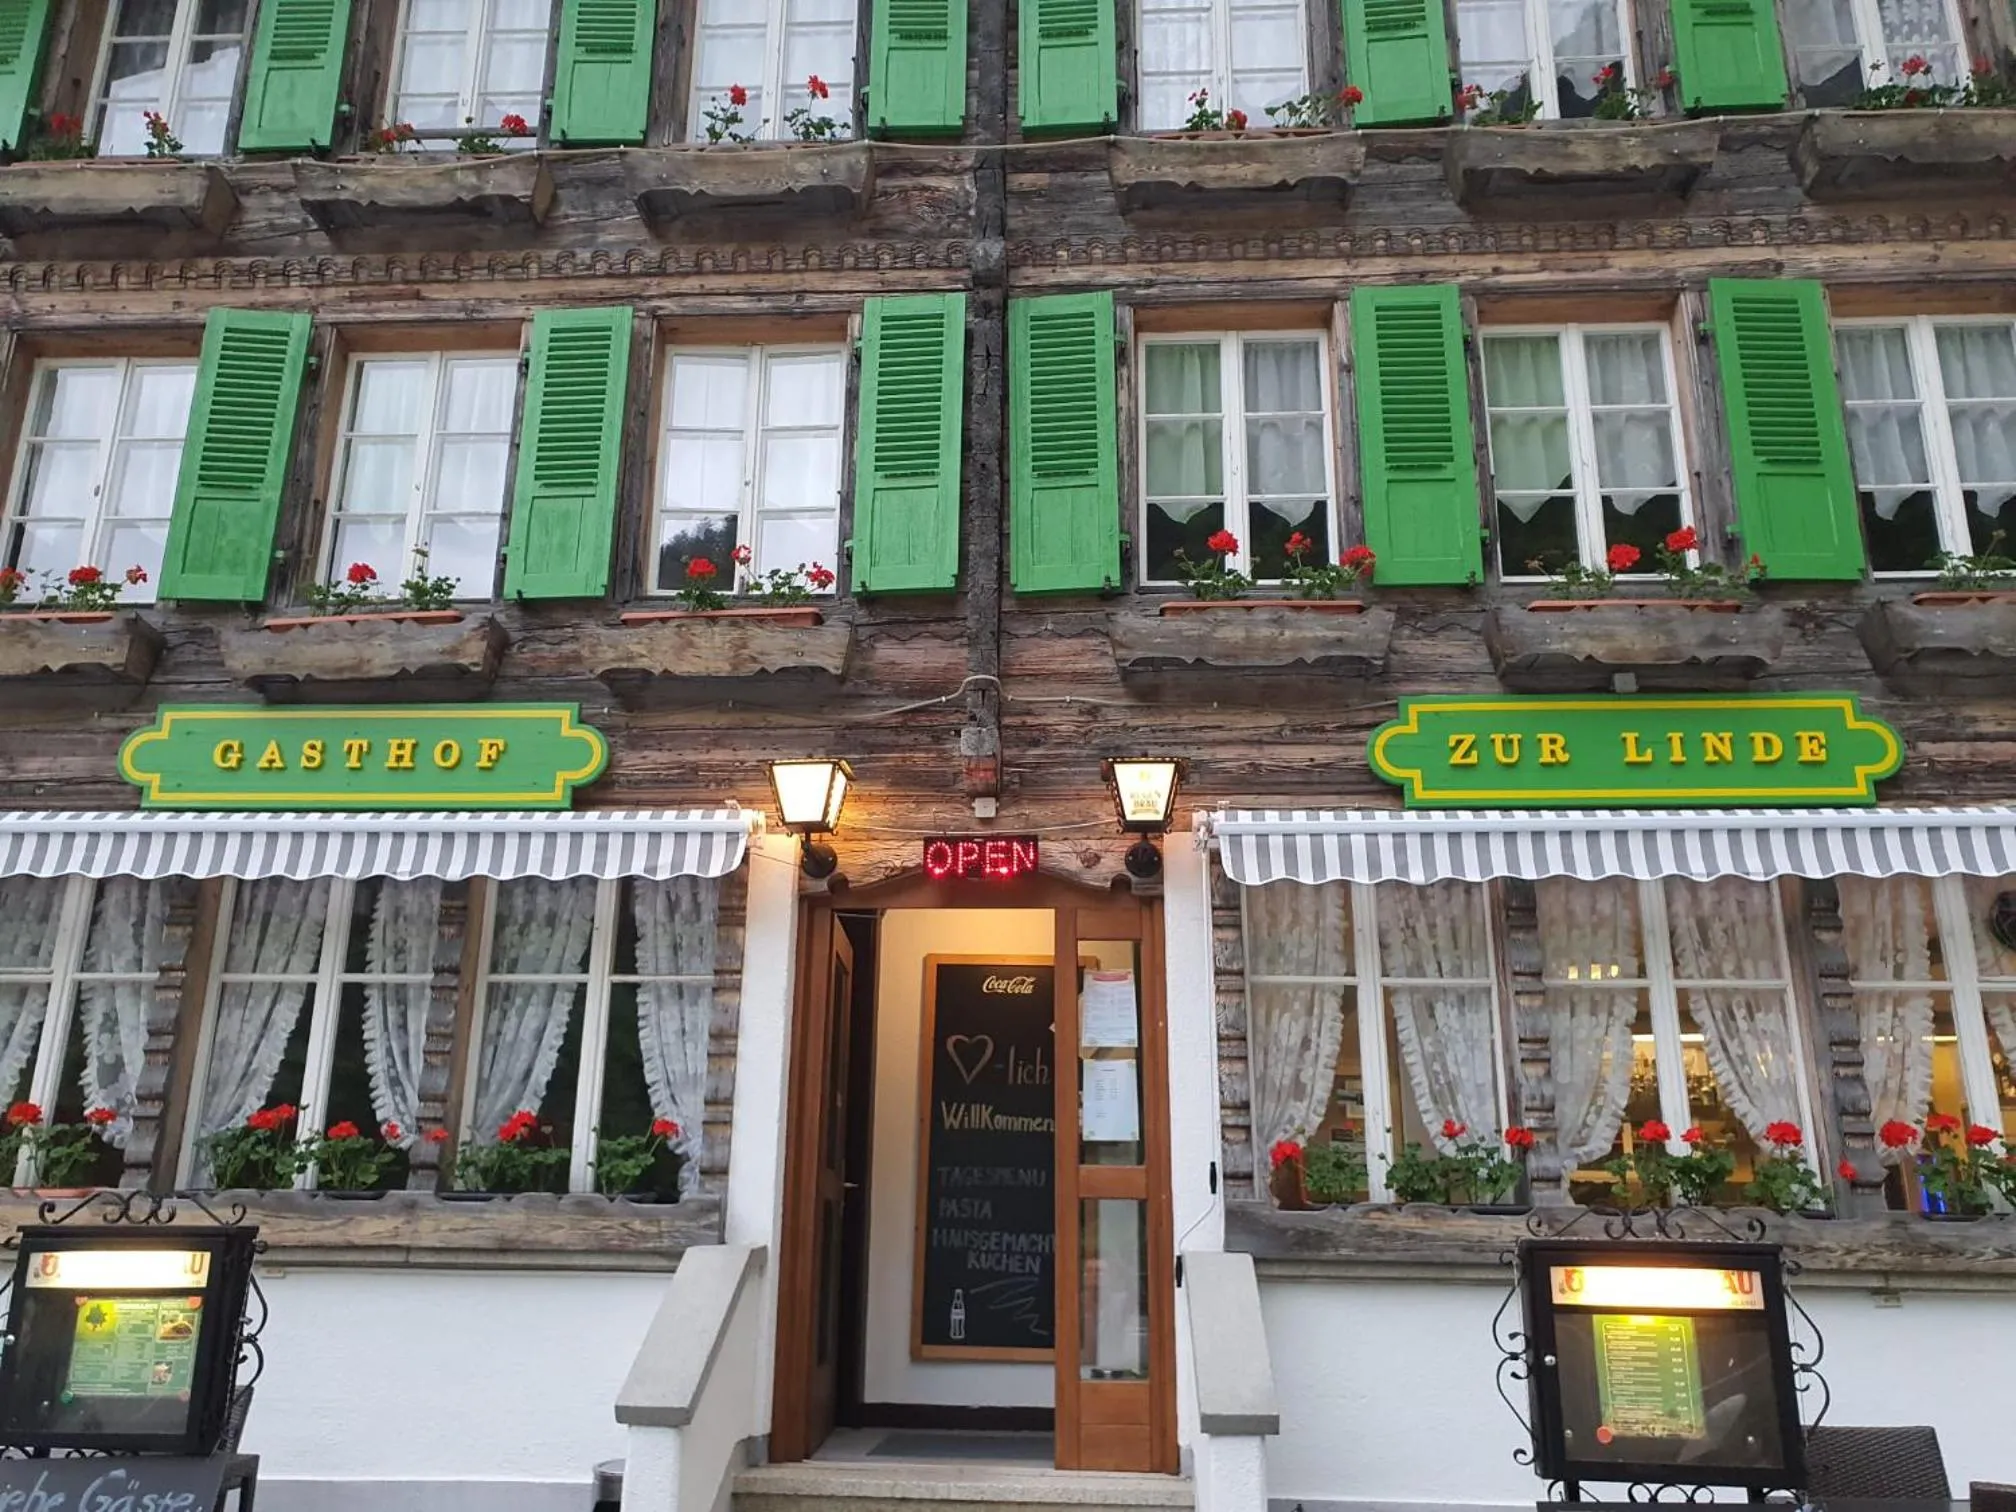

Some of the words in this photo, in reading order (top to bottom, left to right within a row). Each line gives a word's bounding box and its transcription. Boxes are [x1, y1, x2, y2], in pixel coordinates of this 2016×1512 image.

[213, 738, 507, 769] GASTHOF
[1448, 732, 1570, 765] ZUR
[1621, 731, 1828, 764] LINDE
[926, 841, 1034, 874] OPEN
[939, 1197, 992, 1219] PASTA
[967, 1249, 1041, 1274] KUCHEN
